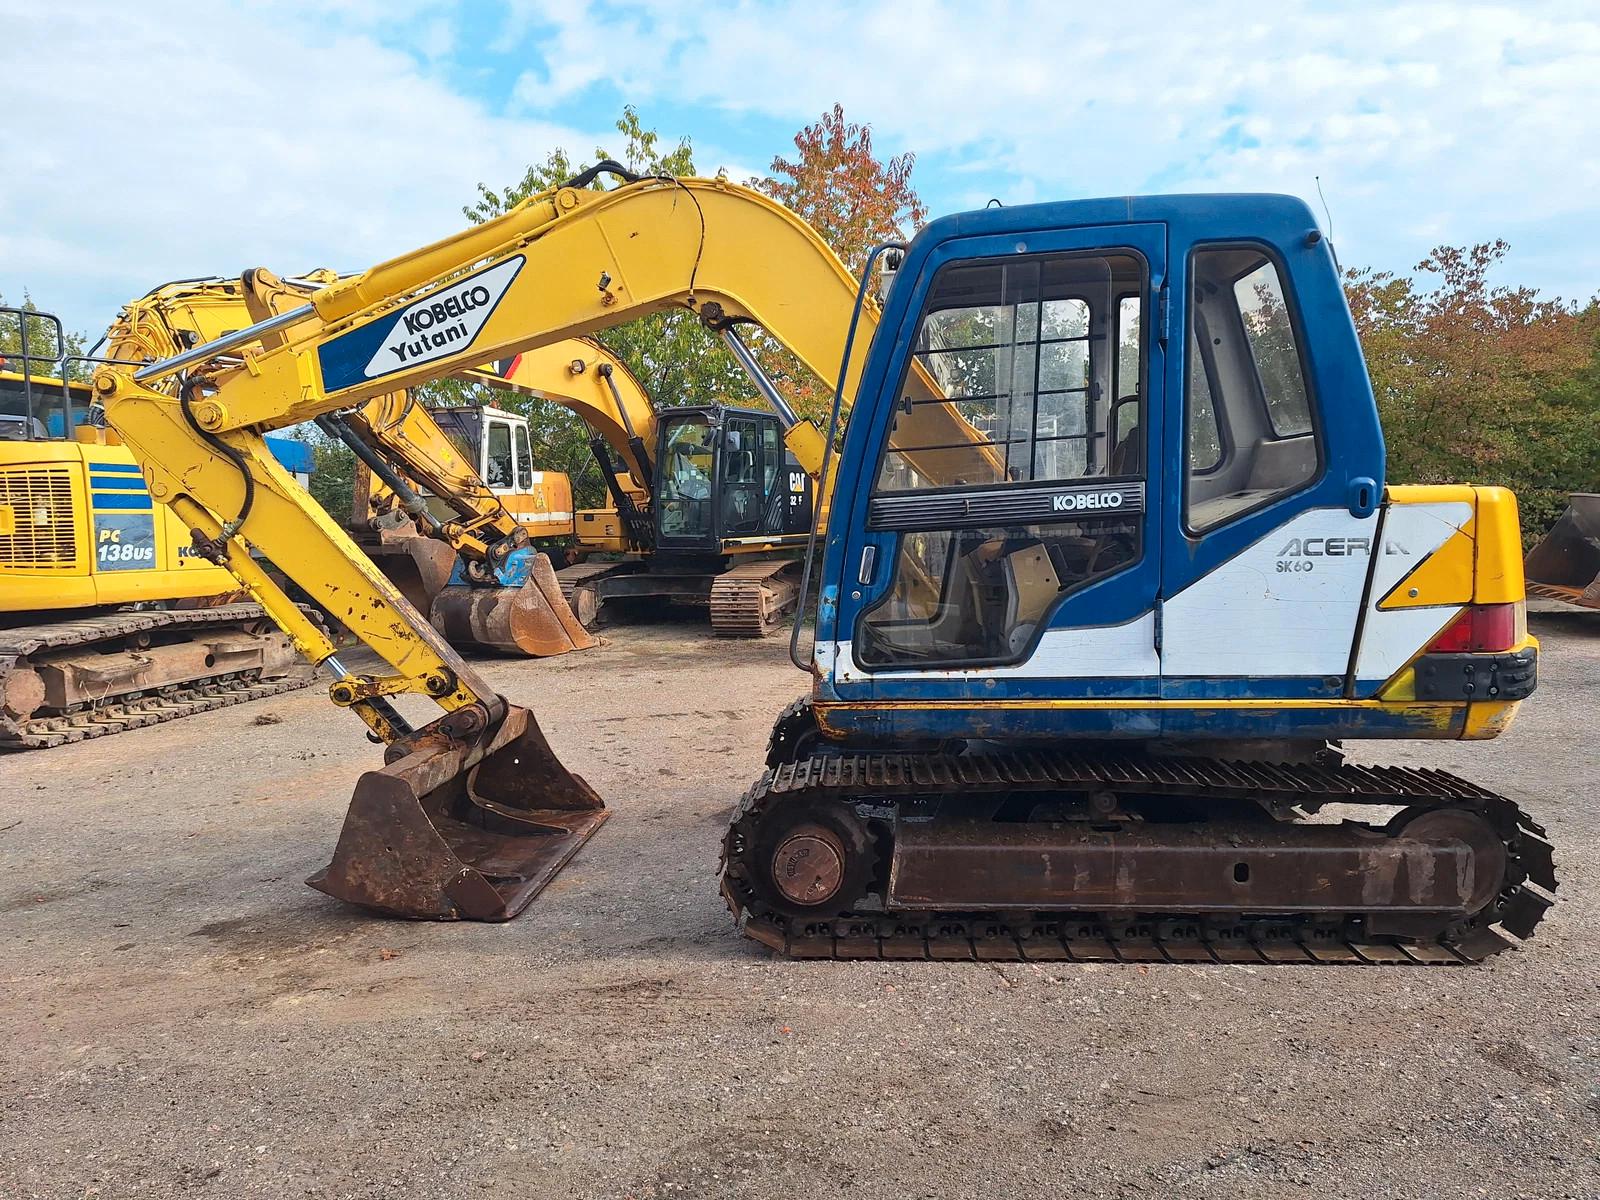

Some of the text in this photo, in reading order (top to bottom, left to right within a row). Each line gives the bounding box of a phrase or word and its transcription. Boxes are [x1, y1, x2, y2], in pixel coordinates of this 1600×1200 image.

[403, 285, 490, 336] KOBELCO
[389, 319, 468, 362] Yutani
[789, 472, 805, 492] CAT
[1053, 492, 1122, 511] KOBELCO
[99, 529, 121, 543] PC
[1275, 560, 1314, 573] SK60
